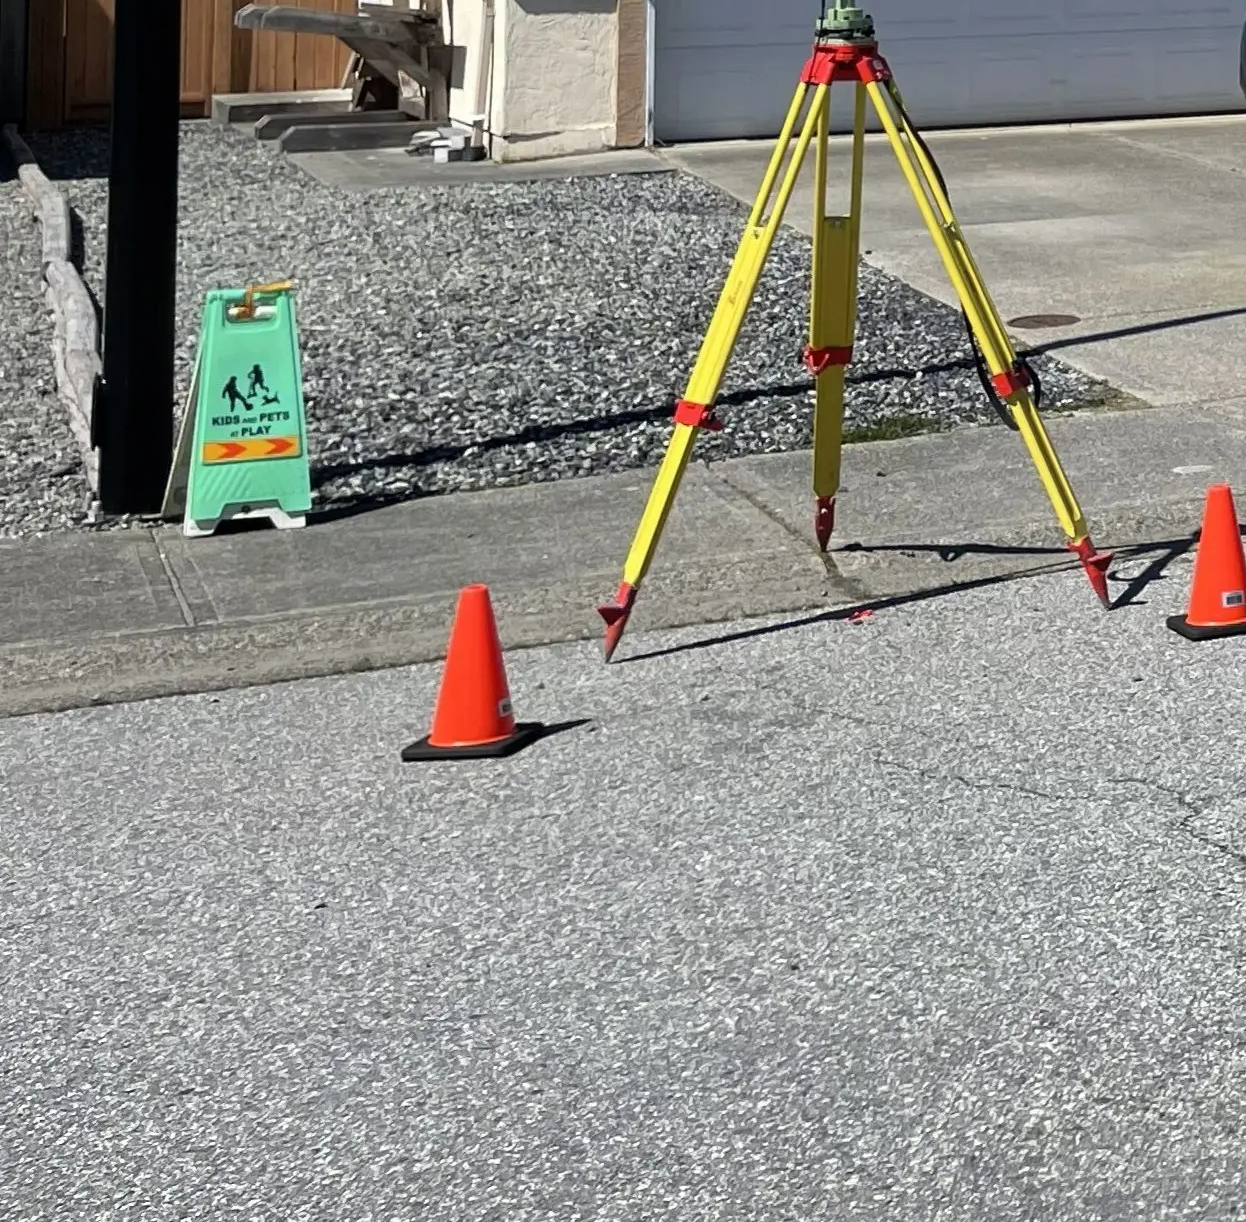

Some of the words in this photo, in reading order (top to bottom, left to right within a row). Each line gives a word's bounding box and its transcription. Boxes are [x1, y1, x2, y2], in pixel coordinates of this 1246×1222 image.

[212, 414, 240, 426] KIDS
[259, 410, 290, 423] PETS
[241, 425, 272, 436] PLAY
